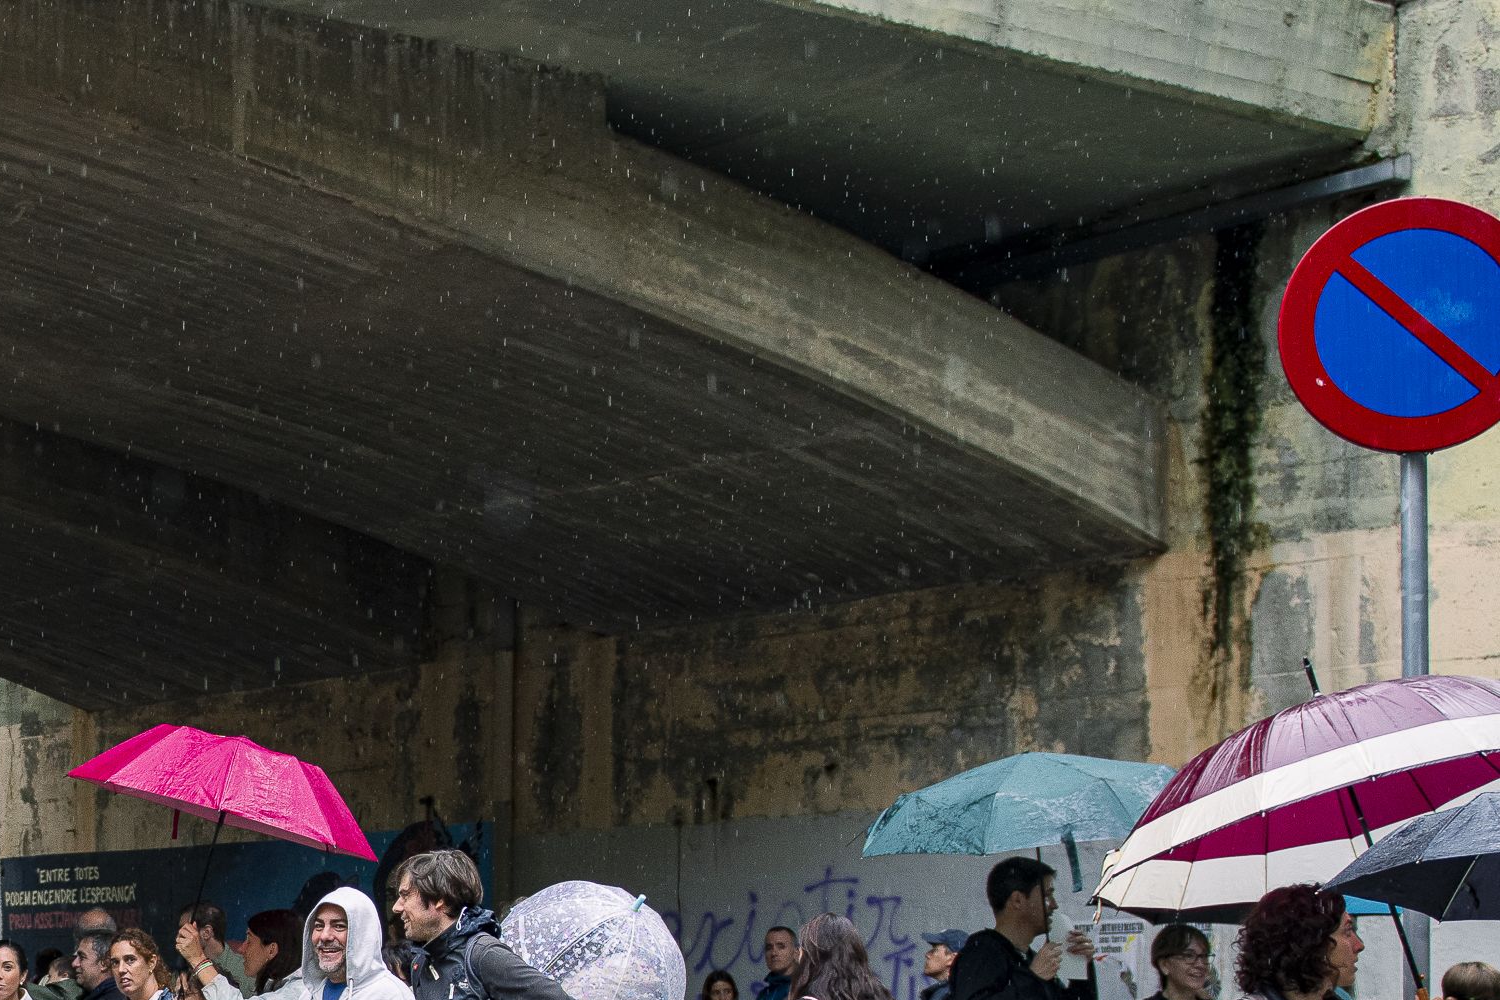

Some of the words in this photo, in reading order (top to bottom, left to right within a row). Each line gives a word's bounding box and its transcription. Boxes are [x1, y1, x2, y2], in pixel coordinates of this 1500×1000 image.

[74, 866, 100, 881] TOTES
[4, 891, 31, 906] PODEM
[32, 888, 78, 906] ENCENDRE
